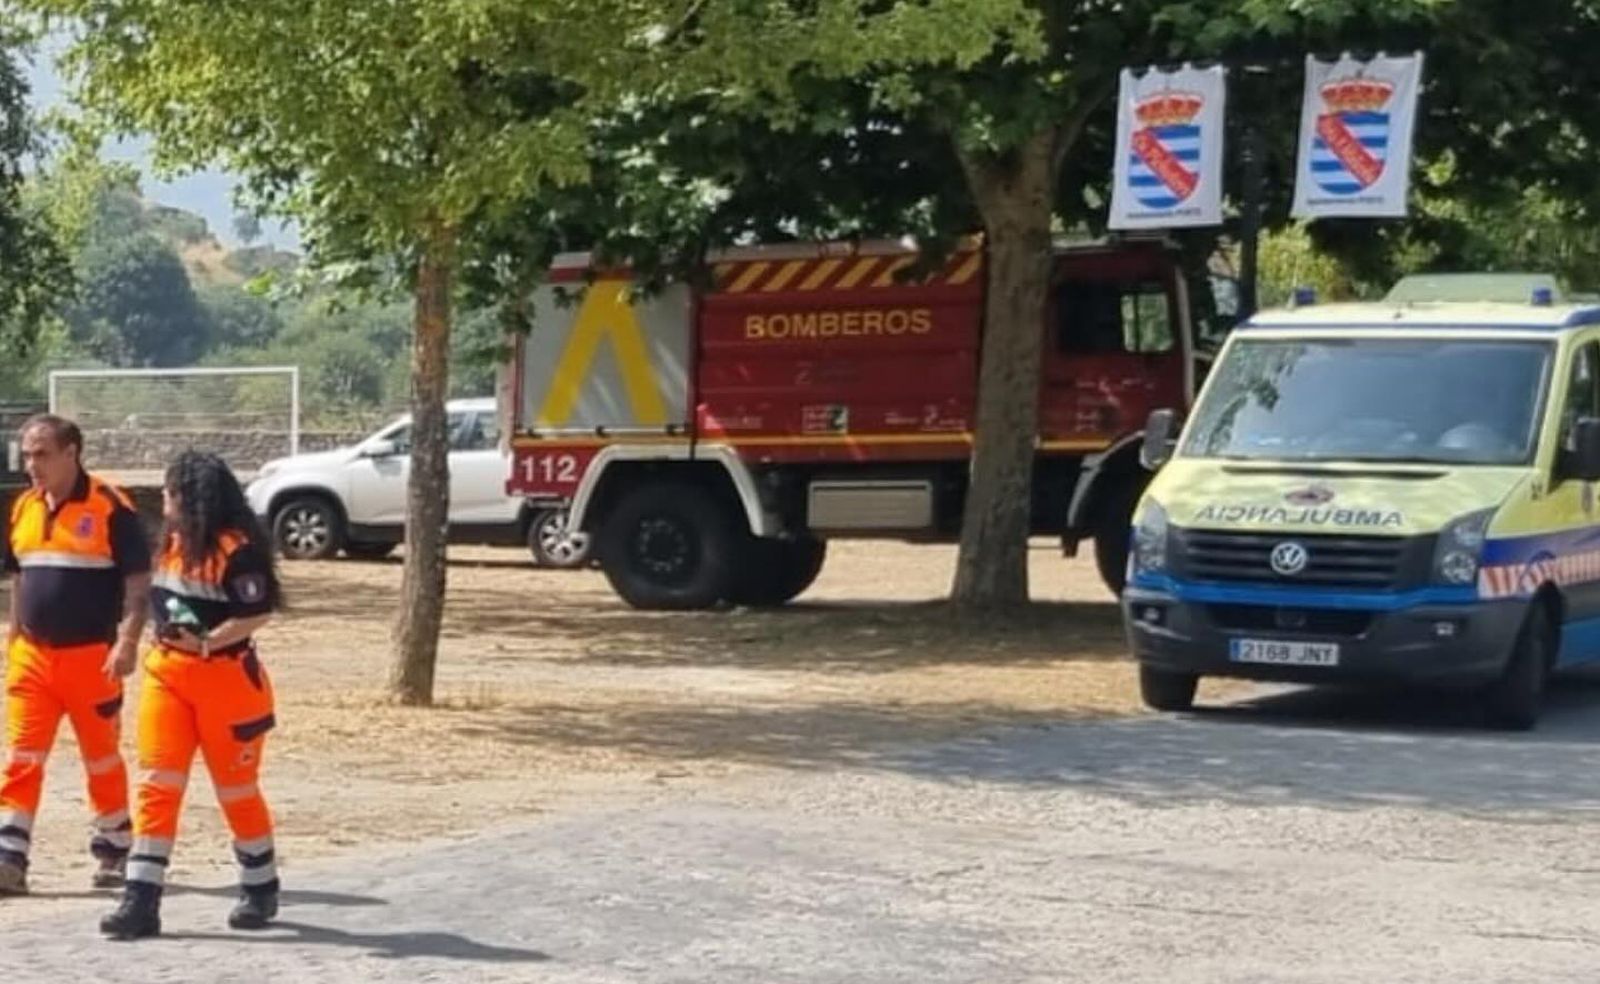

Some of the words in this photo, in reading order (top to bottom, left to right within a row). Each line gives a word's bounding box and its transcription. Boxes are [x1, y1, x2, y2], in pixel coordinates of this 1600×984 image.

[745, 309, 932, 338] BOMBEROS
[520, 455, 578, 482] 112
[1297, 644, 1333, 663] JNY
